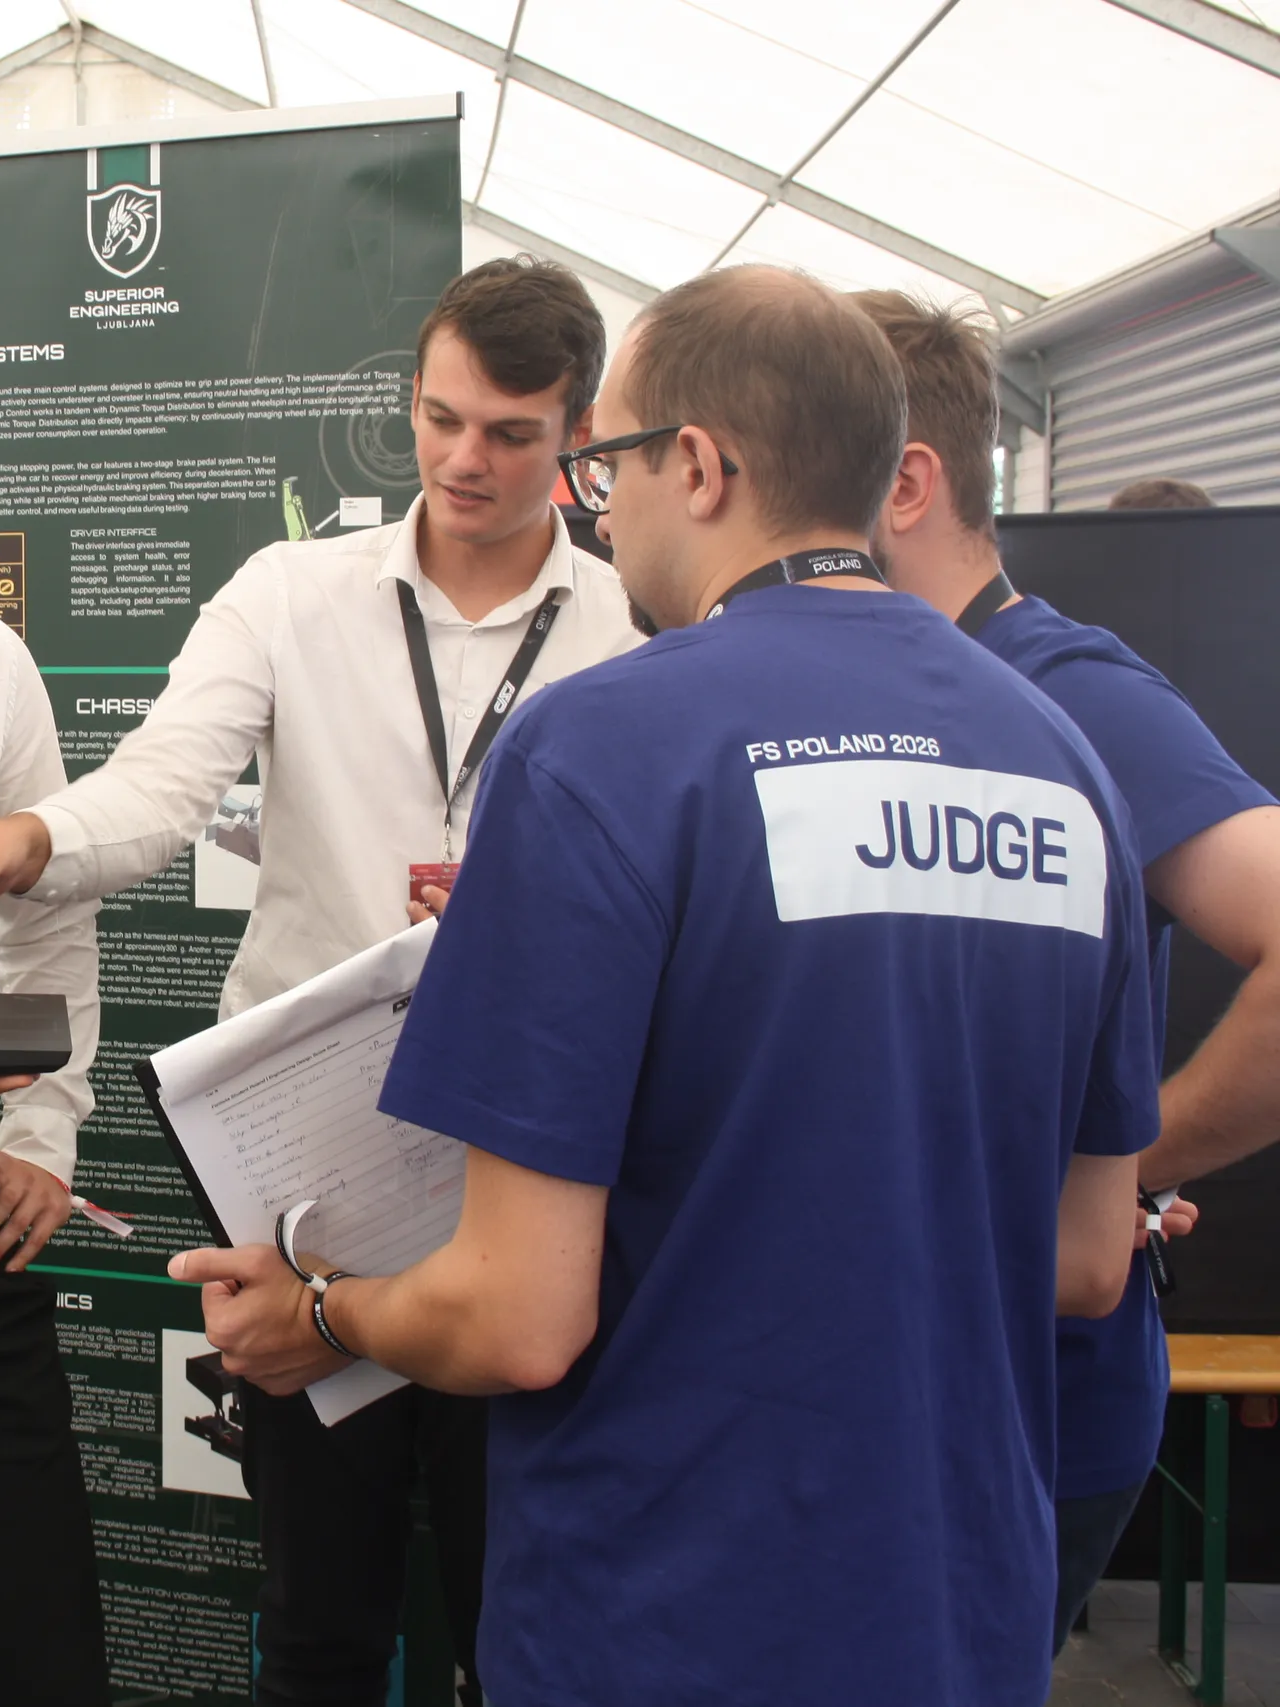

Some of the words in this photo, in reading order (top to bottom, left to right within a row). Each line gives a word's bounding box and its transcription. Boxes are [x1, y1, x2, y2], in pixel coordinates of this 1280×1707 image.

[85, 287, 165, 302] SUPERIOR
[69, 301, 180, 319] ENGINEERING
[96, 319, 155, 330] LJUBLJANA
[14, 385, 32, 394] three
[34, 384, 51, 394] main
[52, 383, 77, 393] control
[79, 382, 108, 394] systems
[110, 381, 143, 393] designed
[144, 381, 152, 389] to
[154, 379, 183, 391] optimize
[185, 379, 196, 388] tire
[198, 378, 212, 389] grip
[214, 378, 228, 387] and
[230, 378, 252, 388] power
[254, 375, 284, 387] delivery.
[286, 375, 301, 384] The
[303, 372, 360, 385] implementation
[363, 372, 371, 381] of
[374, 371, 400, 383] Torque
[1, 397, 27, 408] actively
[28, 396, 56, 405] corrects
[58, 394, 95, 404] understeer
[97, 394, 110, 403] and
[111, 392, 144, 402] oversteer
[145, 392, 152, 401] in
[152, 392, 166, 401] real
[166, 391, 182, 401] time,
[184, 390, 213, 402] ensuring
[214, 389, 238, 398] neutral
[239, 388, 269, 399] handling
[270, 387, 284, 396] and
[285, 387, 301, 398] high
[302, 386, 325, 395] lateral
[326, 384, 375, 396] performance
[376, 383, 400, 394] during
[70, 529, 106, 538] DRIVER
[107, 527, 157, 536] INTERFACE
[71, 542, 84, 550] The
[85, 541, 105, 550] driver
[106, 541, 136, 550] interface
[136, 541, 155, 552] gives
[155, 540, 190, 549] immediate
[99, 552, 107, 561] to
[114, 552, 139, 563] system
[145, 551, 168, 561] health,
[808, 554, 836, 564] FORMULA
[71, 565, 108, 575] messages,
[113, 563, 148, 574] precharge
[152, 563, 174, 572] status,
[177, 562, 190, 571] and
[812, 558, 861, 574] POLAND
[71, 575, 108, 586] debugging
[116, 574, 156, 583] information.
[164, 574, 169, 582] It
[176, 574, 190, 582] also
[71, 586, 101, 597] supports
[101, 586, 120, 596] quick
[120, 585, 140, 596] setup
[140, 585, 169, 596] changes
[169, 585, 191, 596] during
[71, 597, 96, 608] testing,
[100, 597, 131, 608] including
[134, 596, 153, 607] pedal
[156, 596, 191, 605] calibration
[71, 608, 85, 617] and
[86, 608, 106, 617] brake
[107, 608, 122, 616] bias
[126, 608, 165, 618] adjustment.
[64, 731, 77, 739] with
[78, 731, 88, 739] the
[90, 731, 114, 741] primary
[746, 741, 781, 763] FS
[787, 734, 885, 759] POLAND
[890, 734, 940, 757] 2026
[855, 800, 1067, 886] JUDGE
[143, 882, 156, 890] from
[158, 883, 190, 893] glass-fiber-
[118, 892, 136, 900] added
[137, 893, 165, 903] lightening
[166, 894, 189, 904] pockets.
[109, 931, 124, 940] such
[132, 932, 142, 940] the
[143, 933, 167, 941] harness
[167, 933, 179, 942] and
[179, 934, 194, 942] main
[194, 934, 210, 945] hoop
[58, 1339, 101, 1351] closed-loop
[104, 1343, 139, 1355] approach
[141, 1347, 156, 1355] that
